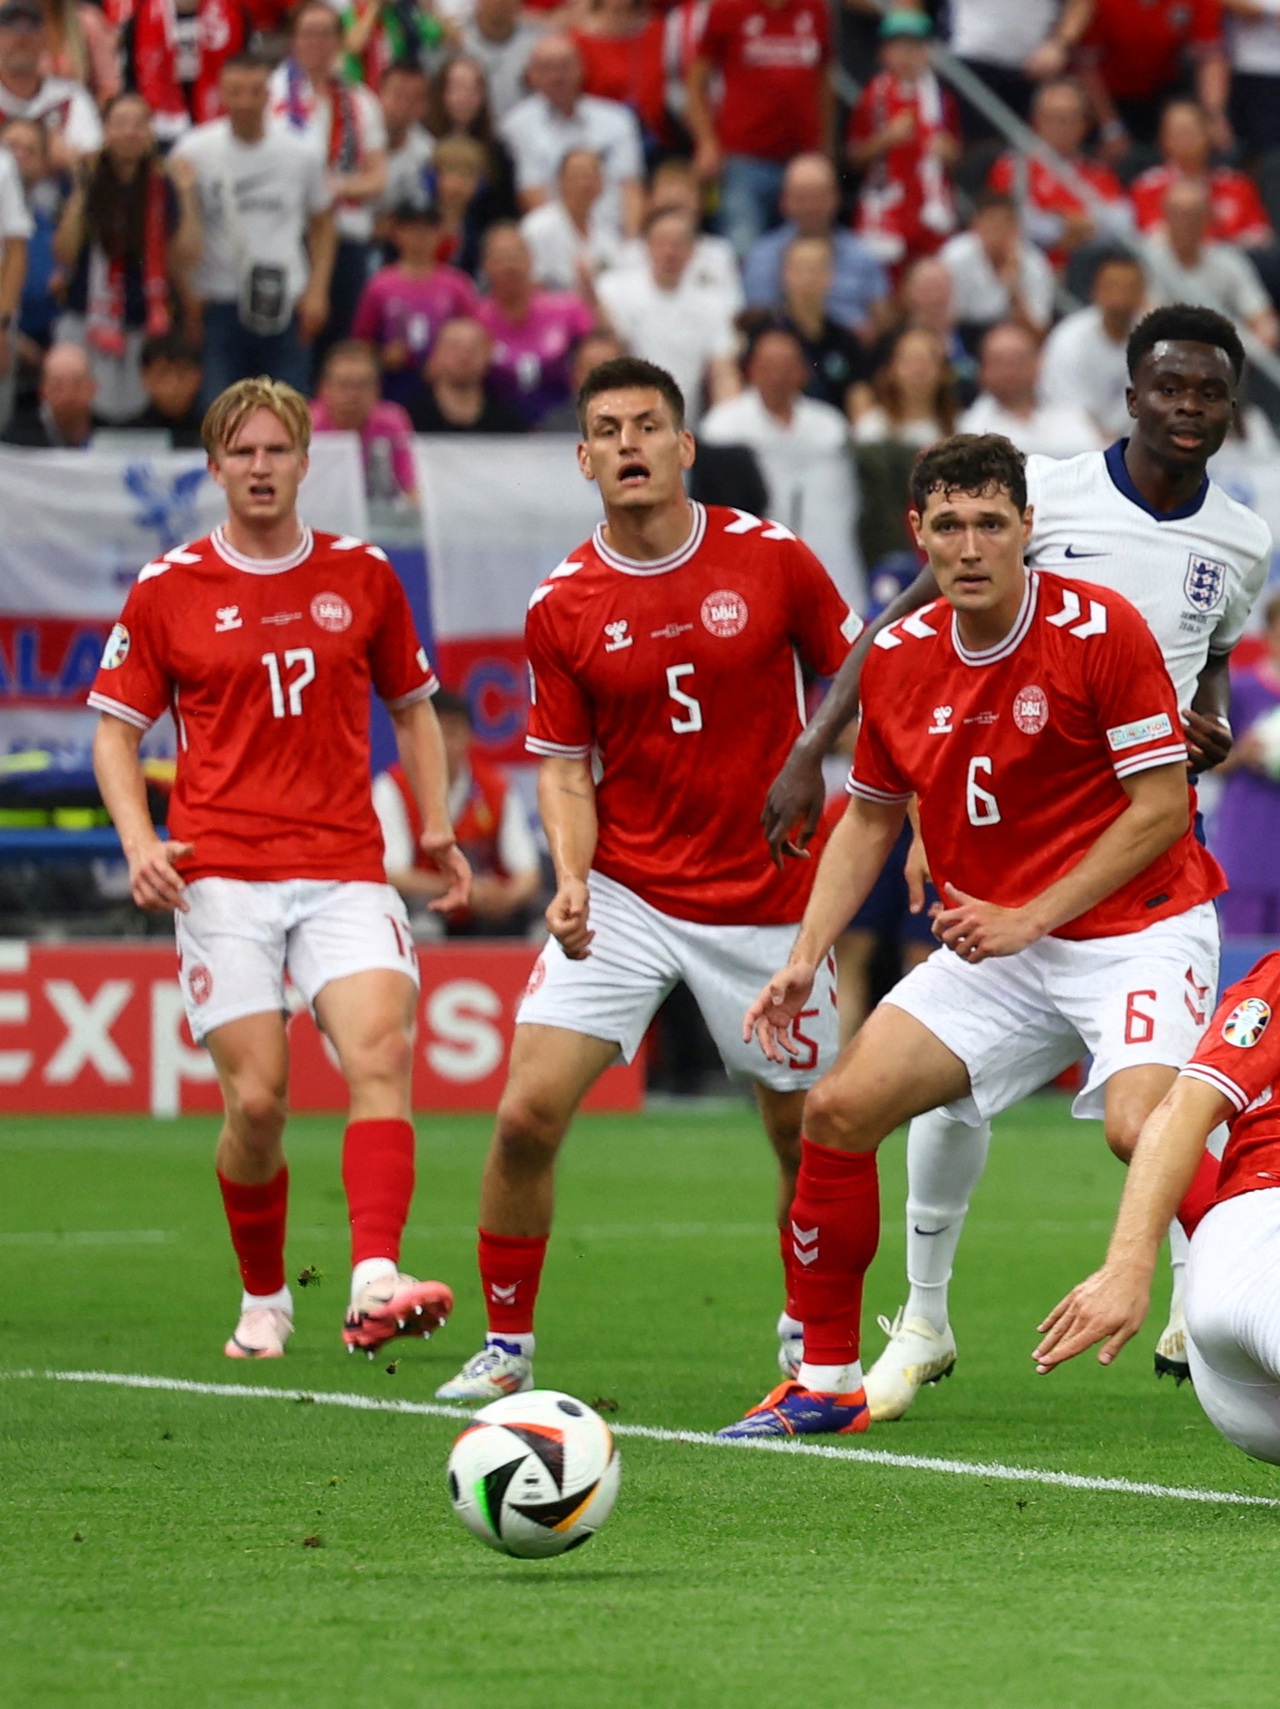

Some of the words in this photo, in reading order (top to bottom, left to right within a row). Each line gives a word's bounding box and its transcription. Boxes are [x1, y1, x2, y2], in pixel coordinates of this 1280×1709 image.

[261, 647, 316, 718] 17
[665, 662, 703, 734] 5
[965, 756, 1001, 826] 6
[789, 1009, 819, 1071] 5
[1124, 990, 1156, 1044] 6
